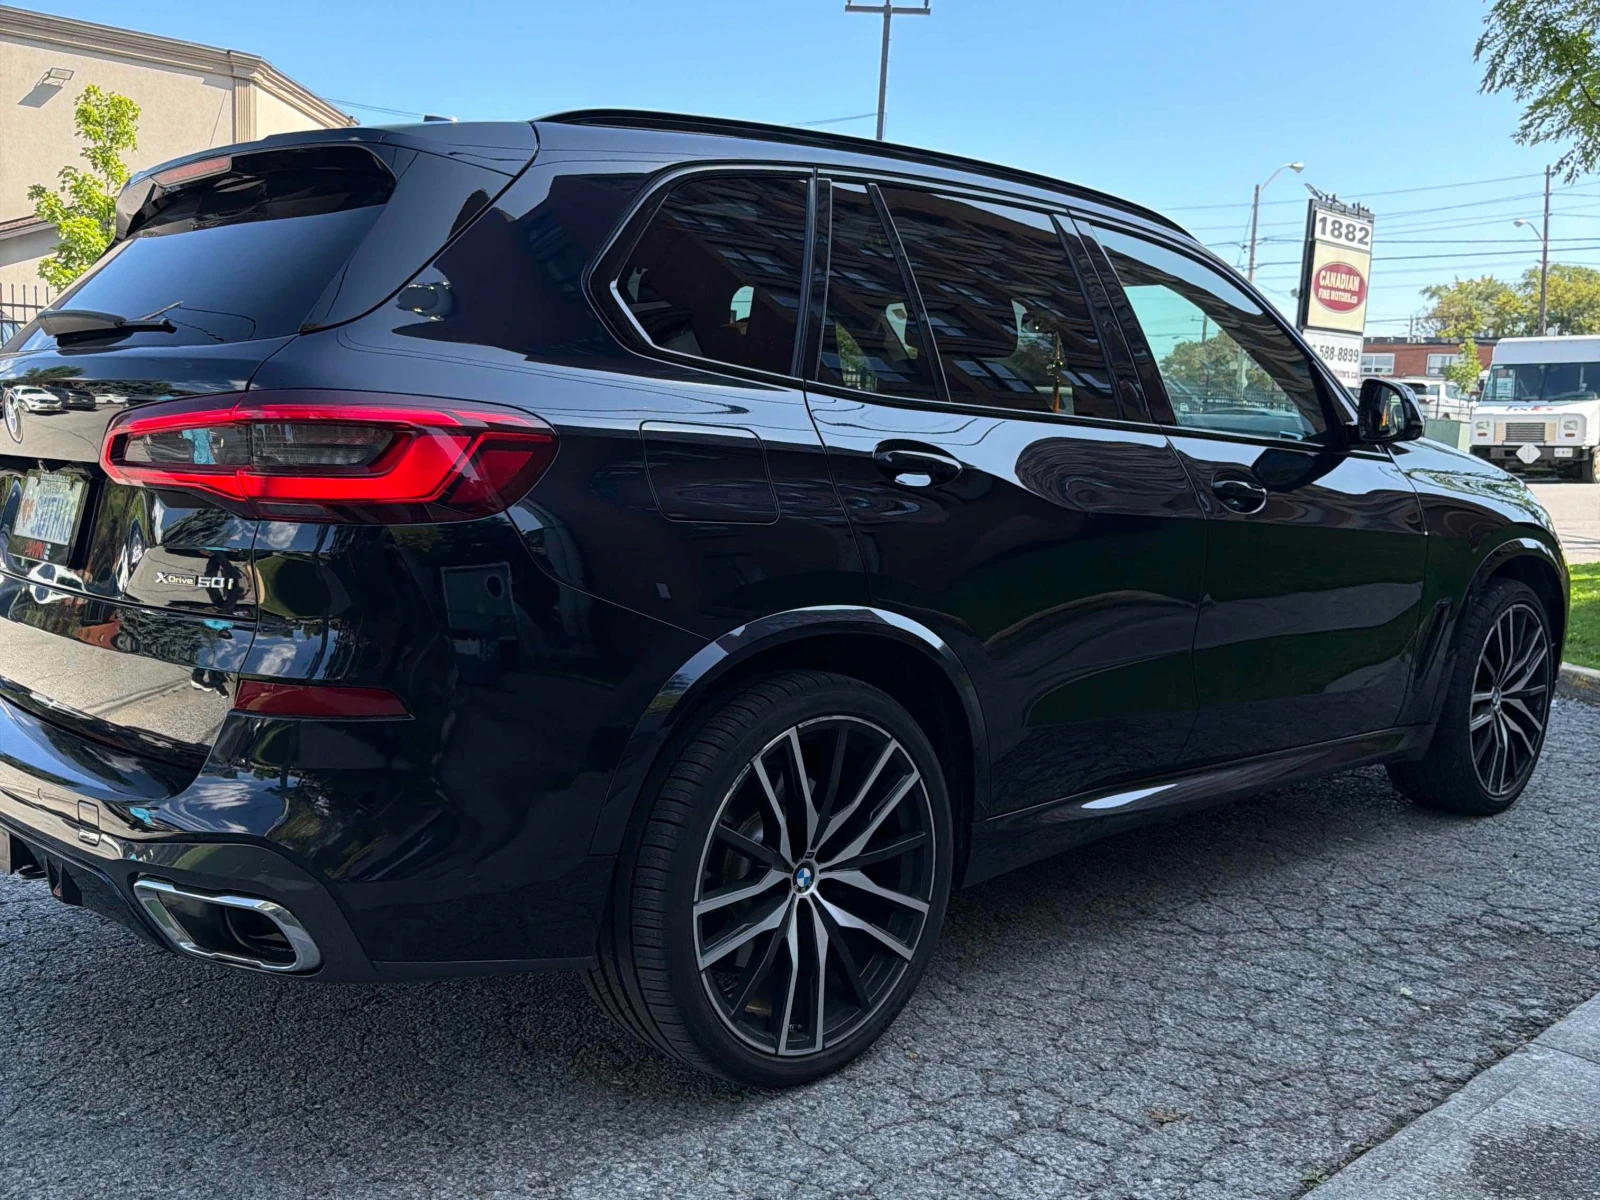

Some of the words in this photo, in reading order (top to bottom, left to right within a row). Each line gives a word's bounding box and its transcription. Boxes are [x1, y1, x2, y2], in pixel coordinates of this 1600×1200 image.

[1319, 216, 1370, 246] 1882
[1319, 270, 1360, 292] CANADIAN
[1318, 287, 1331, 300] FINE
[1320, 345, 1359, 363] 588-8899
